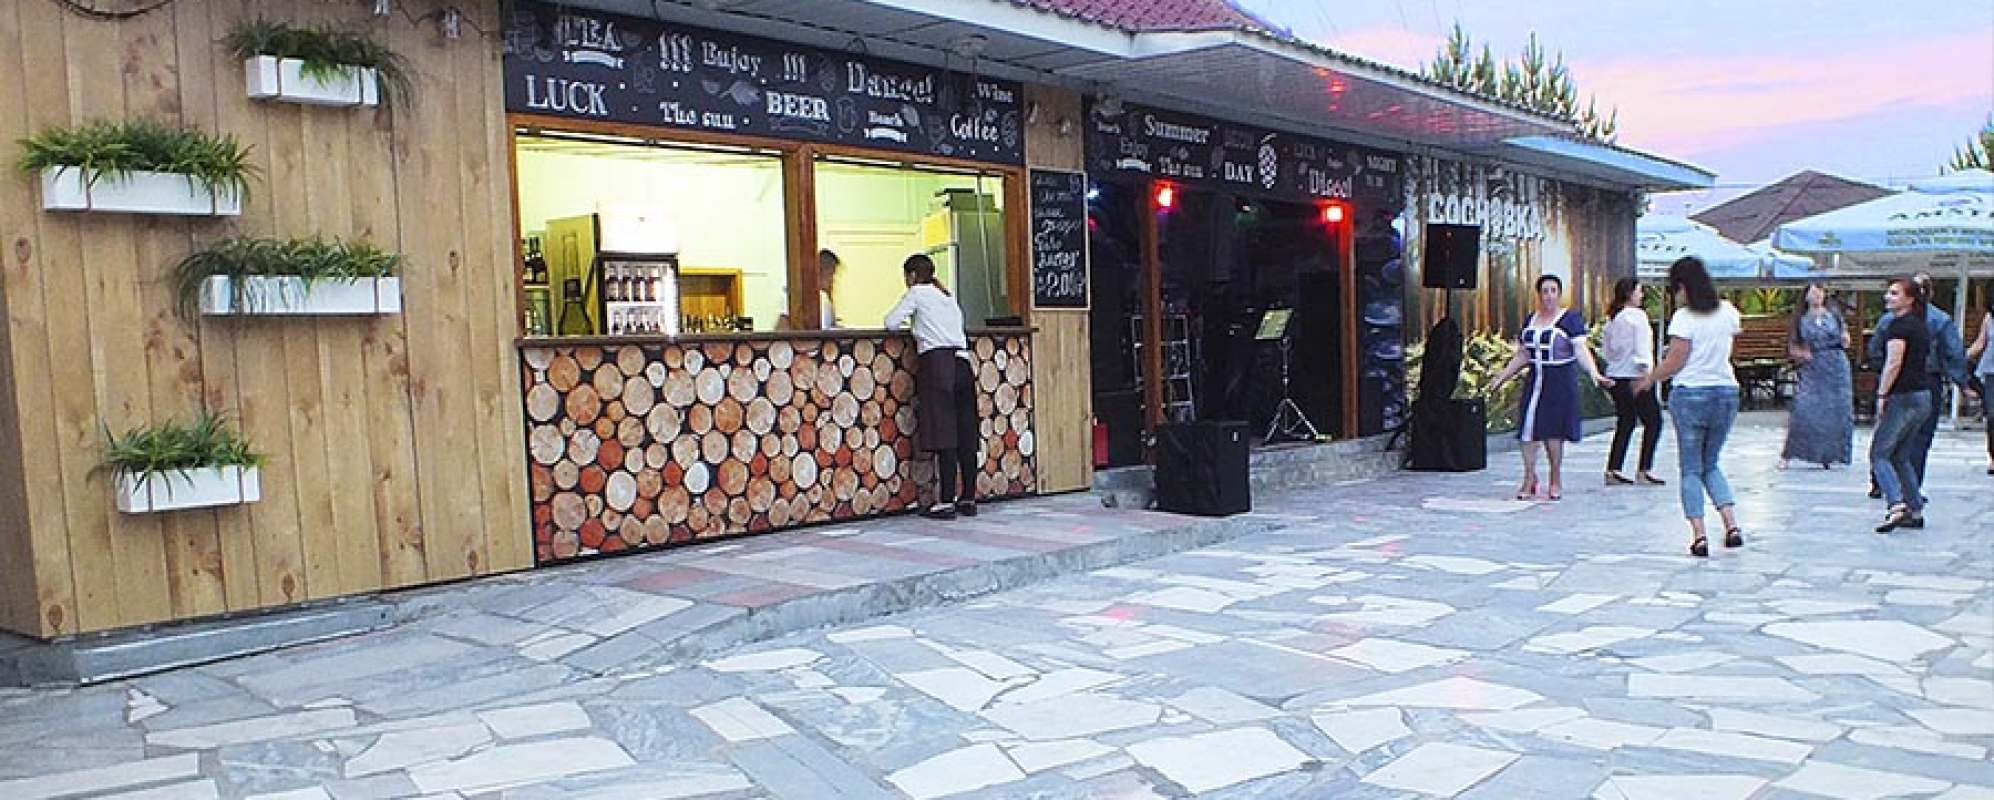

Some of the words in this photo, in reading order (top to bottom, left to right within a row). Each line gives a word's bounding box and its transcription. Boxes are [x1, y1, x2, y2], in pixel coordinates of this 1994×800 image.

[702, 40, 762, 76] Enjoy
[526, 74, 609, 116] LUCK
[766, 90, 831, 122] BEER
[659, 101, 697, 125] The
[950, 112, 999, 142] Coffee
[1144, 114, 1211, 145] Summer
